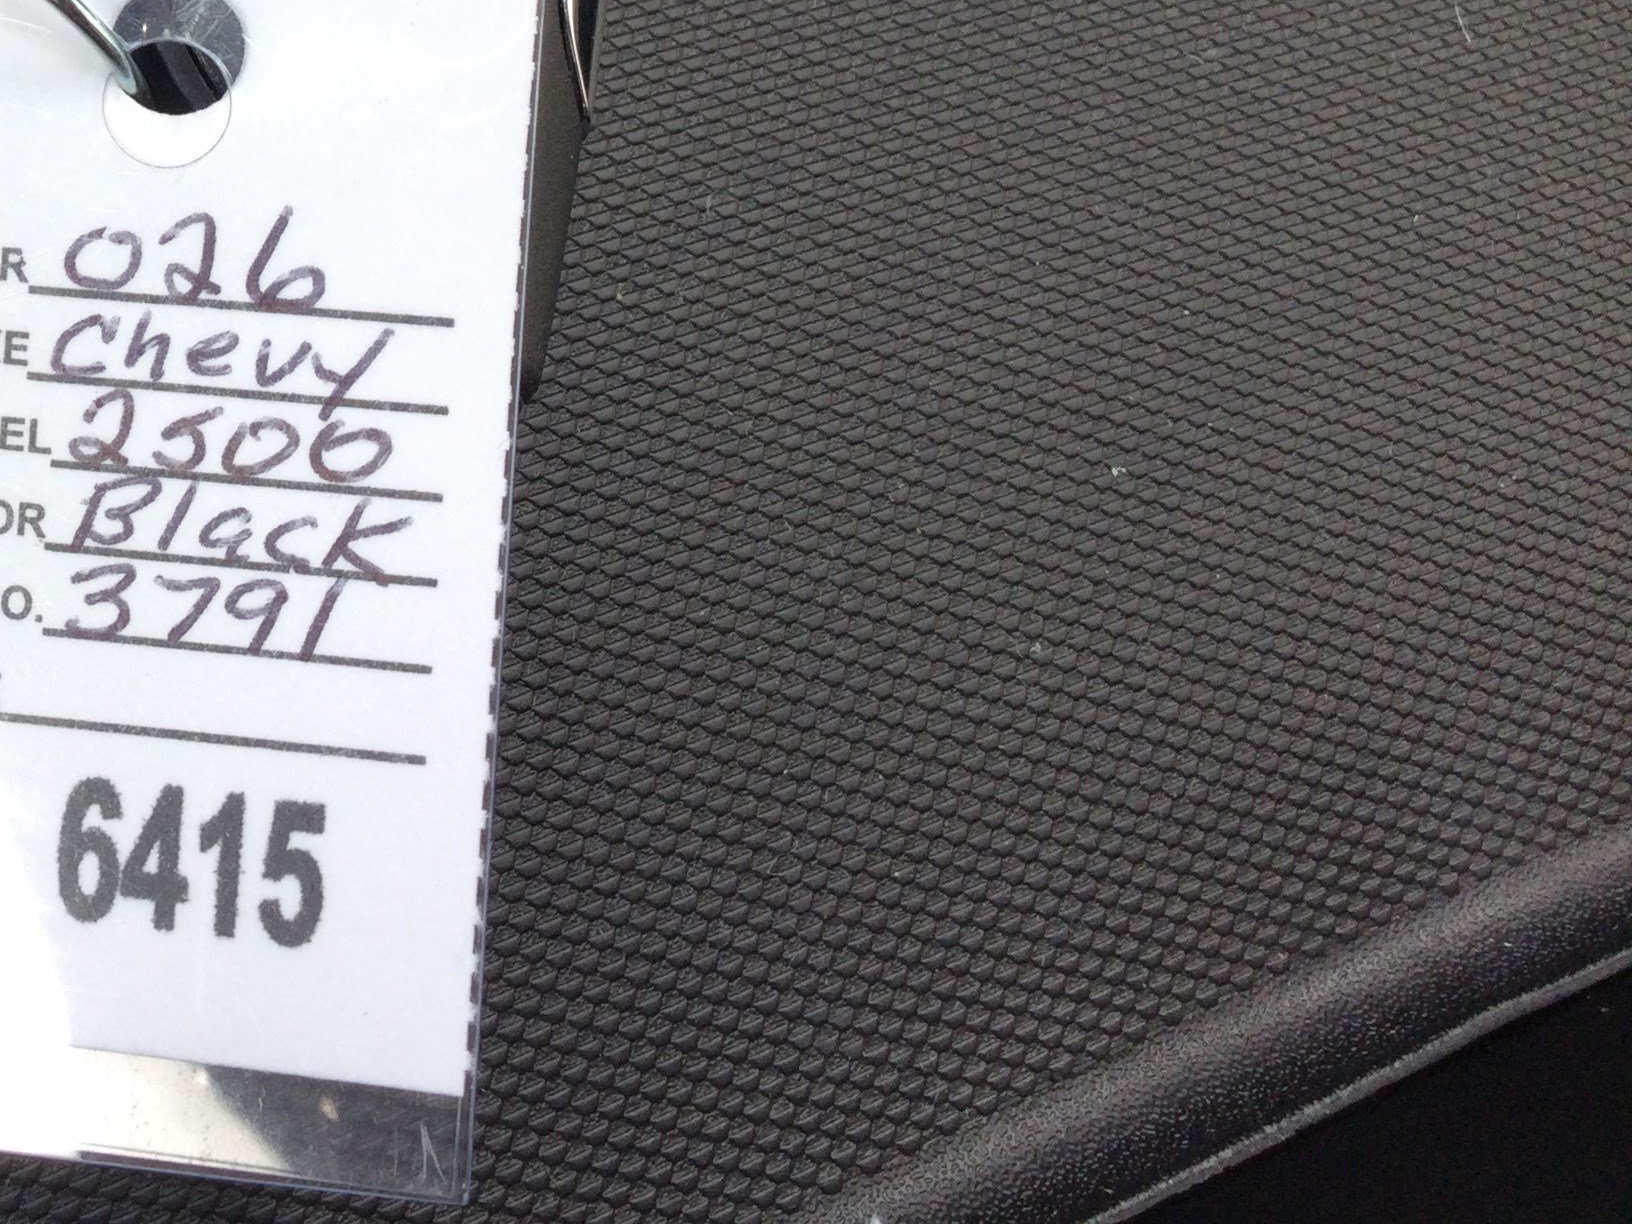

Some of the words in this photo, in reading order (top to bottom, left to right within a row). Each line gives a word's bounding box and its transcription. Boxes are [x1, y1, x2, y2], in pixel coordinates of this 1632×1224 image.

[63, 204, 326, 314] 026
[49, 309, 395, 421] Chevy
[68, 387, 394, 483] 2500
[65, 562, 348, 662] 3791
[56, 776, 326, 948] 6415
